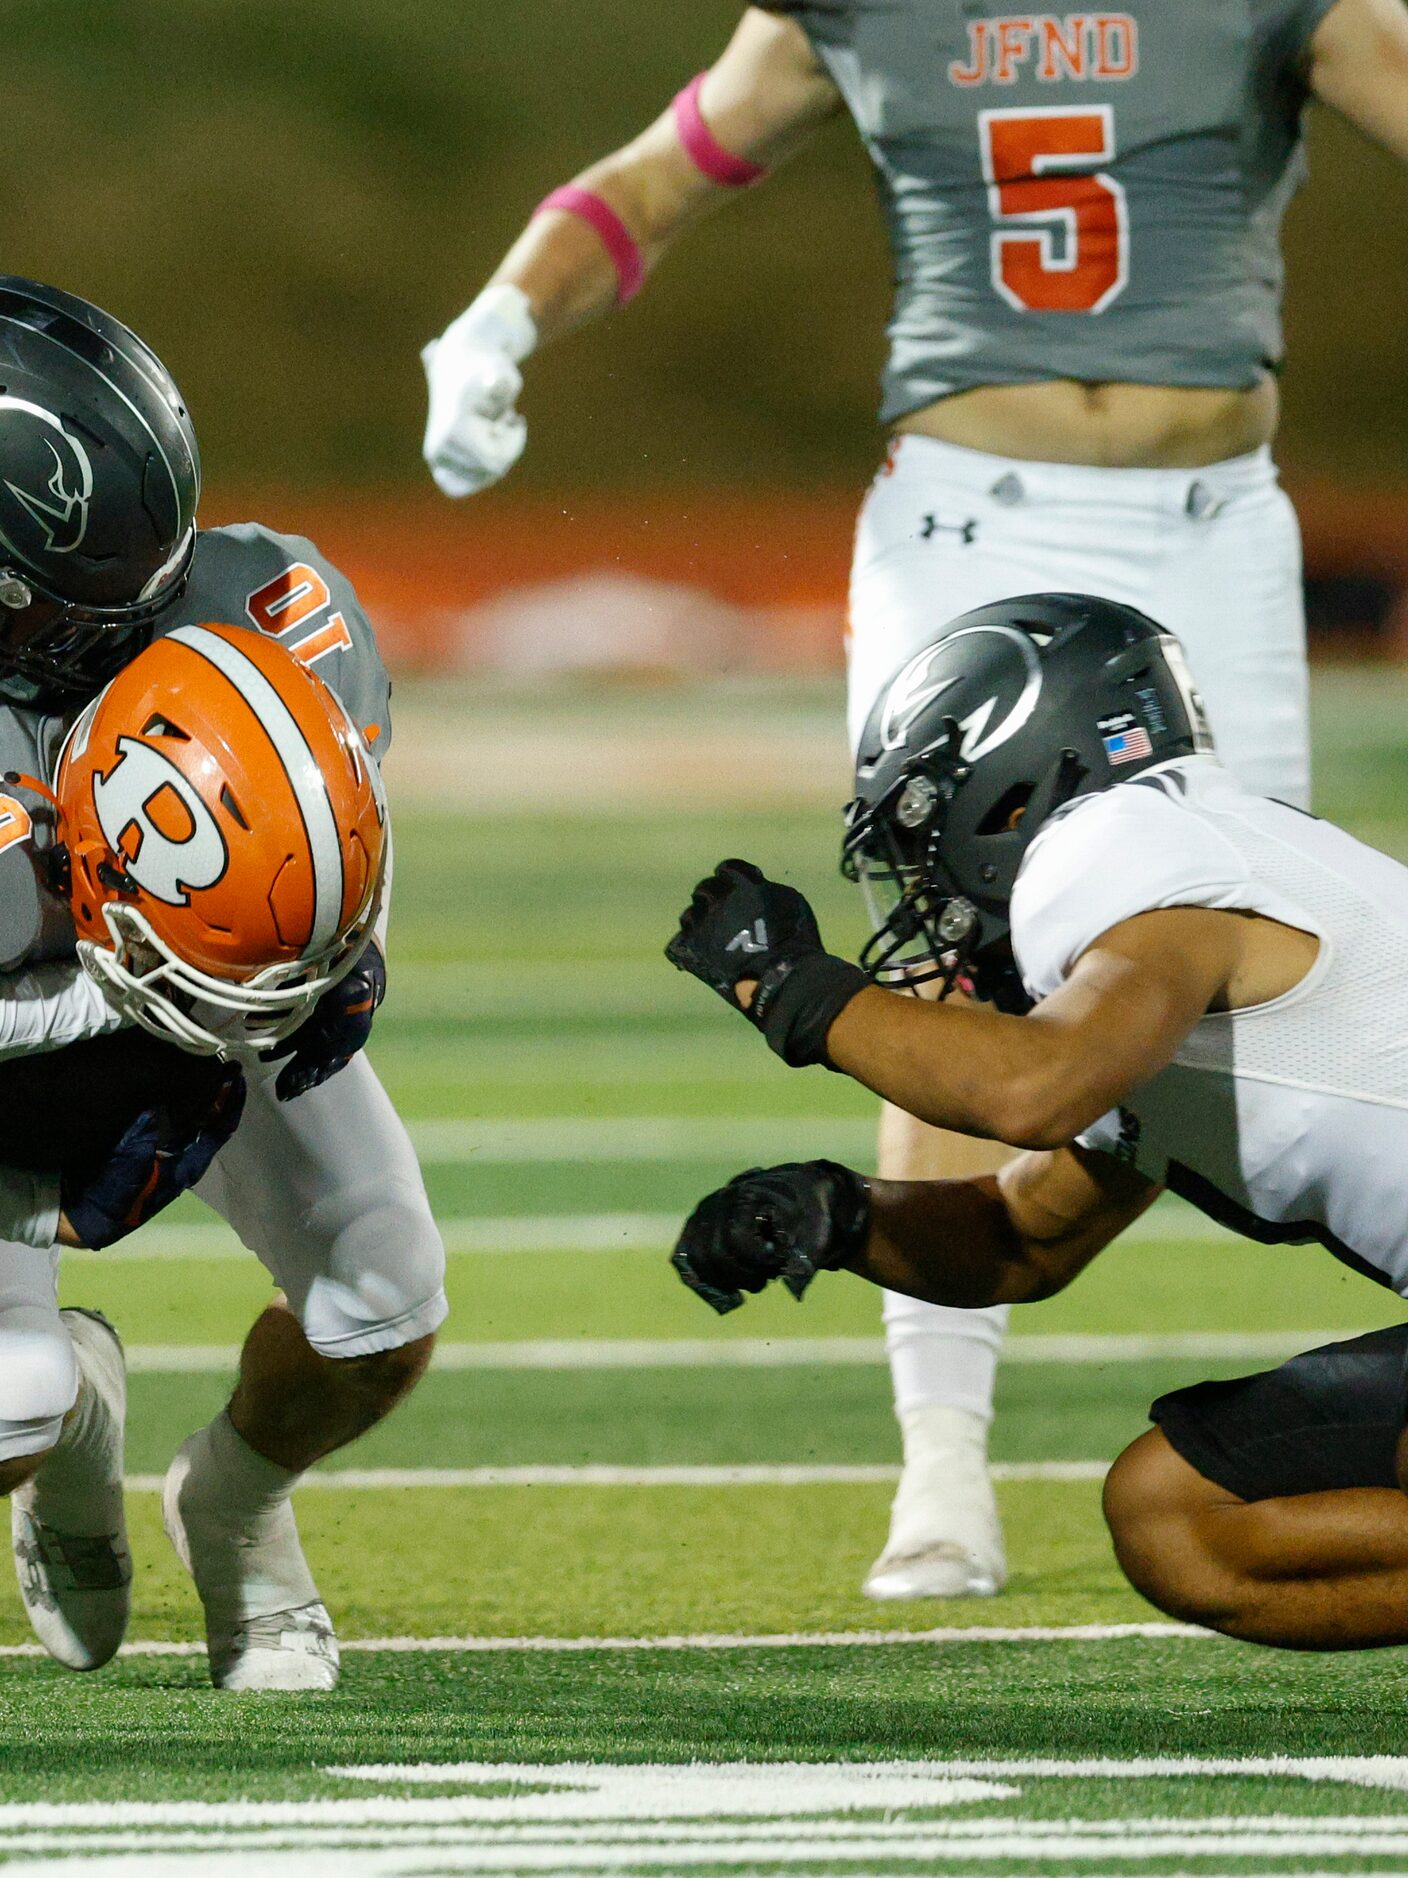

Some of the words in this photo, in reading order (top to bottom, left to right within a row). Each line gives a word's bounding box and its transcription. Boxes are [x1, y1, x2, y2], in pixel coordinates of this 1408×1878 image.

[949, 13, 1138, 88] JFND
[978, 104, 1130, 315] 5
[244, 561, 354, 669] 10
[91, 733, 231, 907] R
